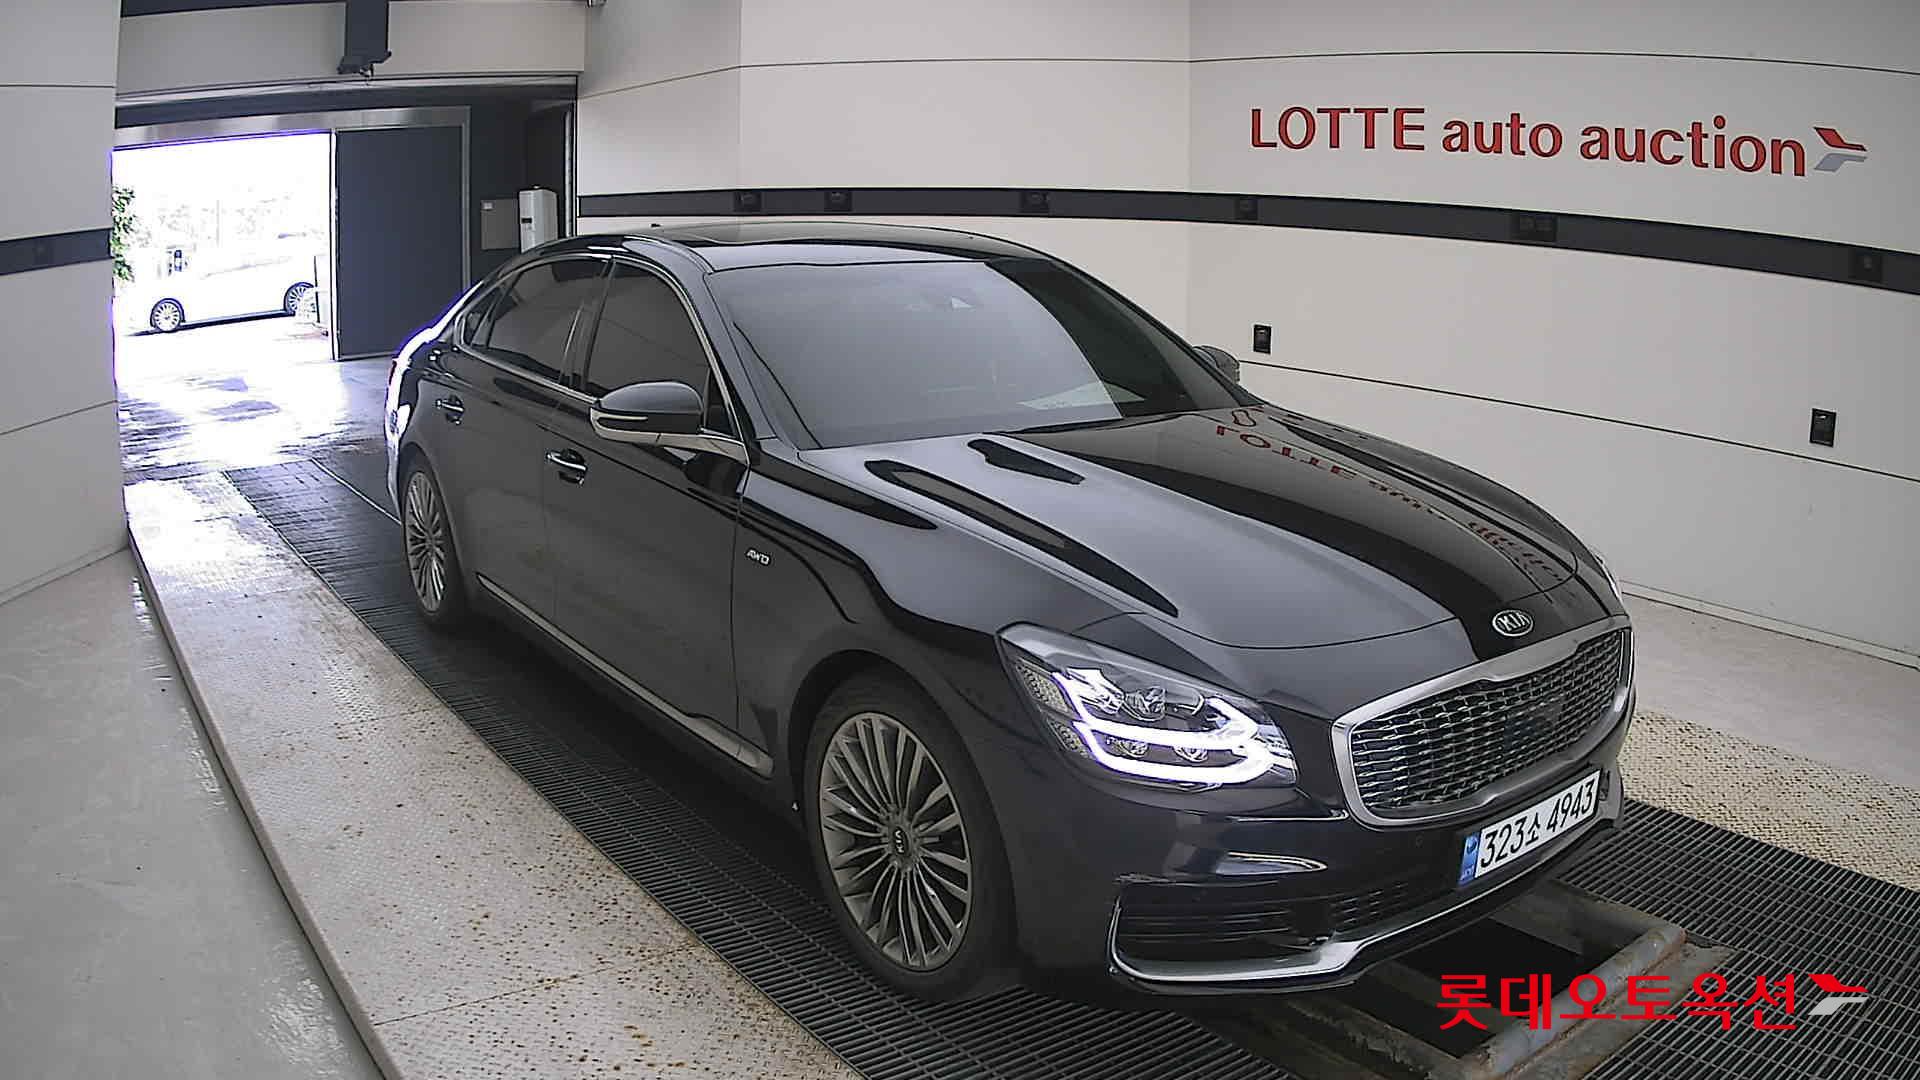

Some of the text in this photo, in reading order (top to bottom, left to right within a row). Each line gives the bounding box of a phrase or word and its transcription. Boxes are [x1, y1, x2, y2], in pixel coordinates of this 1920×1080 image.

[1251, 106, 1806, 177] LOTTE auto auction
[1496, 611, 1531, 632] KIA
[1480, 778, 1597, 868] 323소 4943
